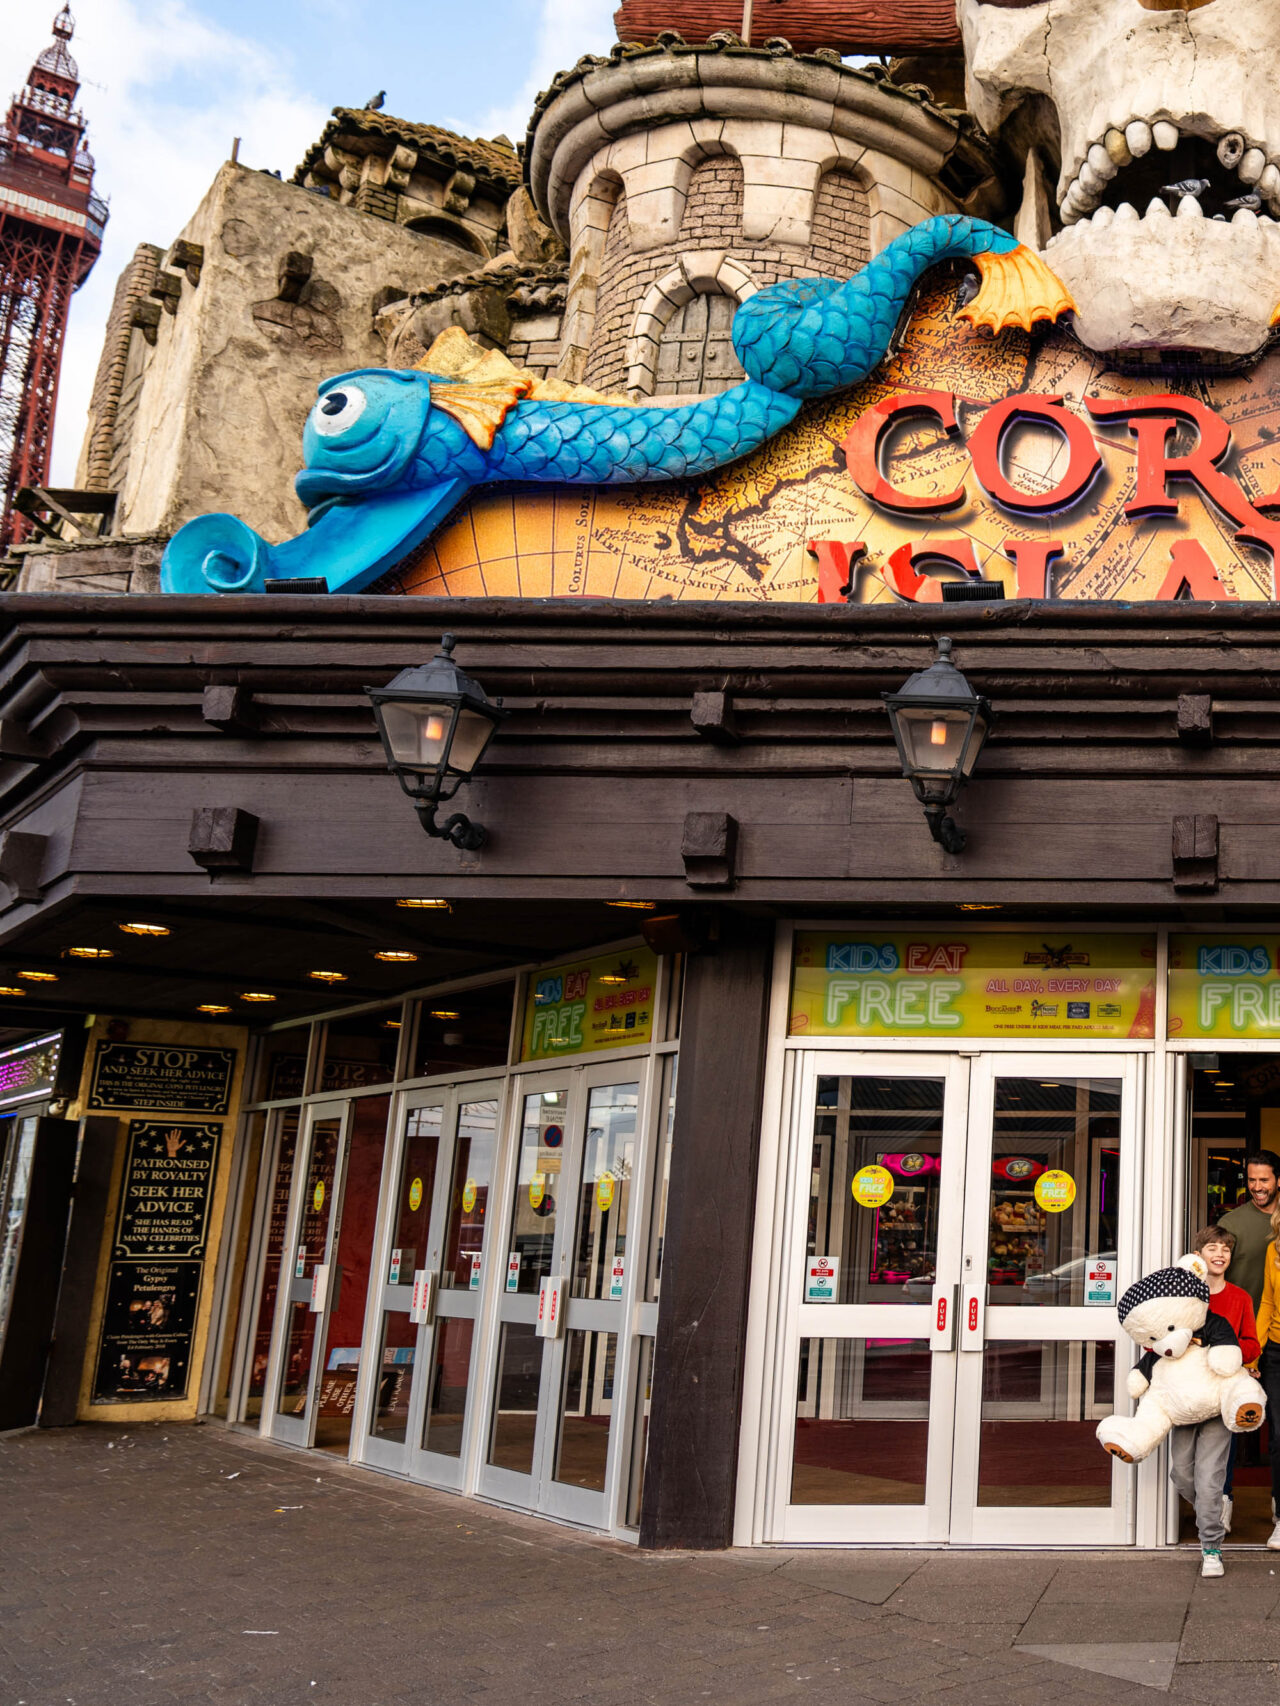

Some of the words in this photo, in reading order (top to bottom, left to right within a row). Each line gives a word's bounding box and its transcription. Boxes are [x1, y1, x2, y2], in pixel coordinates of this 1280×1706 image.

[628, 554, 729, 593] MAGELLANICUM
[828, 945, 898, 972] KIDS
[907, 945, 966, 972] EAT
[1200, 947, 1270, 975] KIDS
[565, 971, 591, 1001] EAT
[986, 979, 1009, 993] ALL
[1014, 979, 1043, 994] DAY,
[1048, 979, 1089, 993] EVERY
[1094, 978, 1121, 993] DAY
[826, 980, 961, 1026] FREE
[531, 1003, 586, 1052] FREE
[134, 1049, 199, 1069] STOP
[102, 1065, 128, 1074] AND
[130, 1066, 158, 1077] SEEK
[160, 1068, 183, 1078] HER
[185, 1070, 225, 1080] ADVICE
[156, 1099, 186, 1108] INSIDE
[133, 1158, 210, 1169] PATRONISED
[132, 1170, 149, 1180] BY
[151, 1171, 208, 1181] ROYALTY
[129, 1185, 169, 1197] SEEK
[172, 1186, 204, 1198] HER
[134, 1201, 194, 1213] ADVICE
[132, 1226, 151, 1234] THE
[151, 1226, 180, 1234] HANDS
[143, 1275, 168, 1284] Gypsy
[319, 1379, 337, 1408] PLEASE
[330, 1386, 342, 1401] USE
[336, 1382, 356, 1407] OTHER
